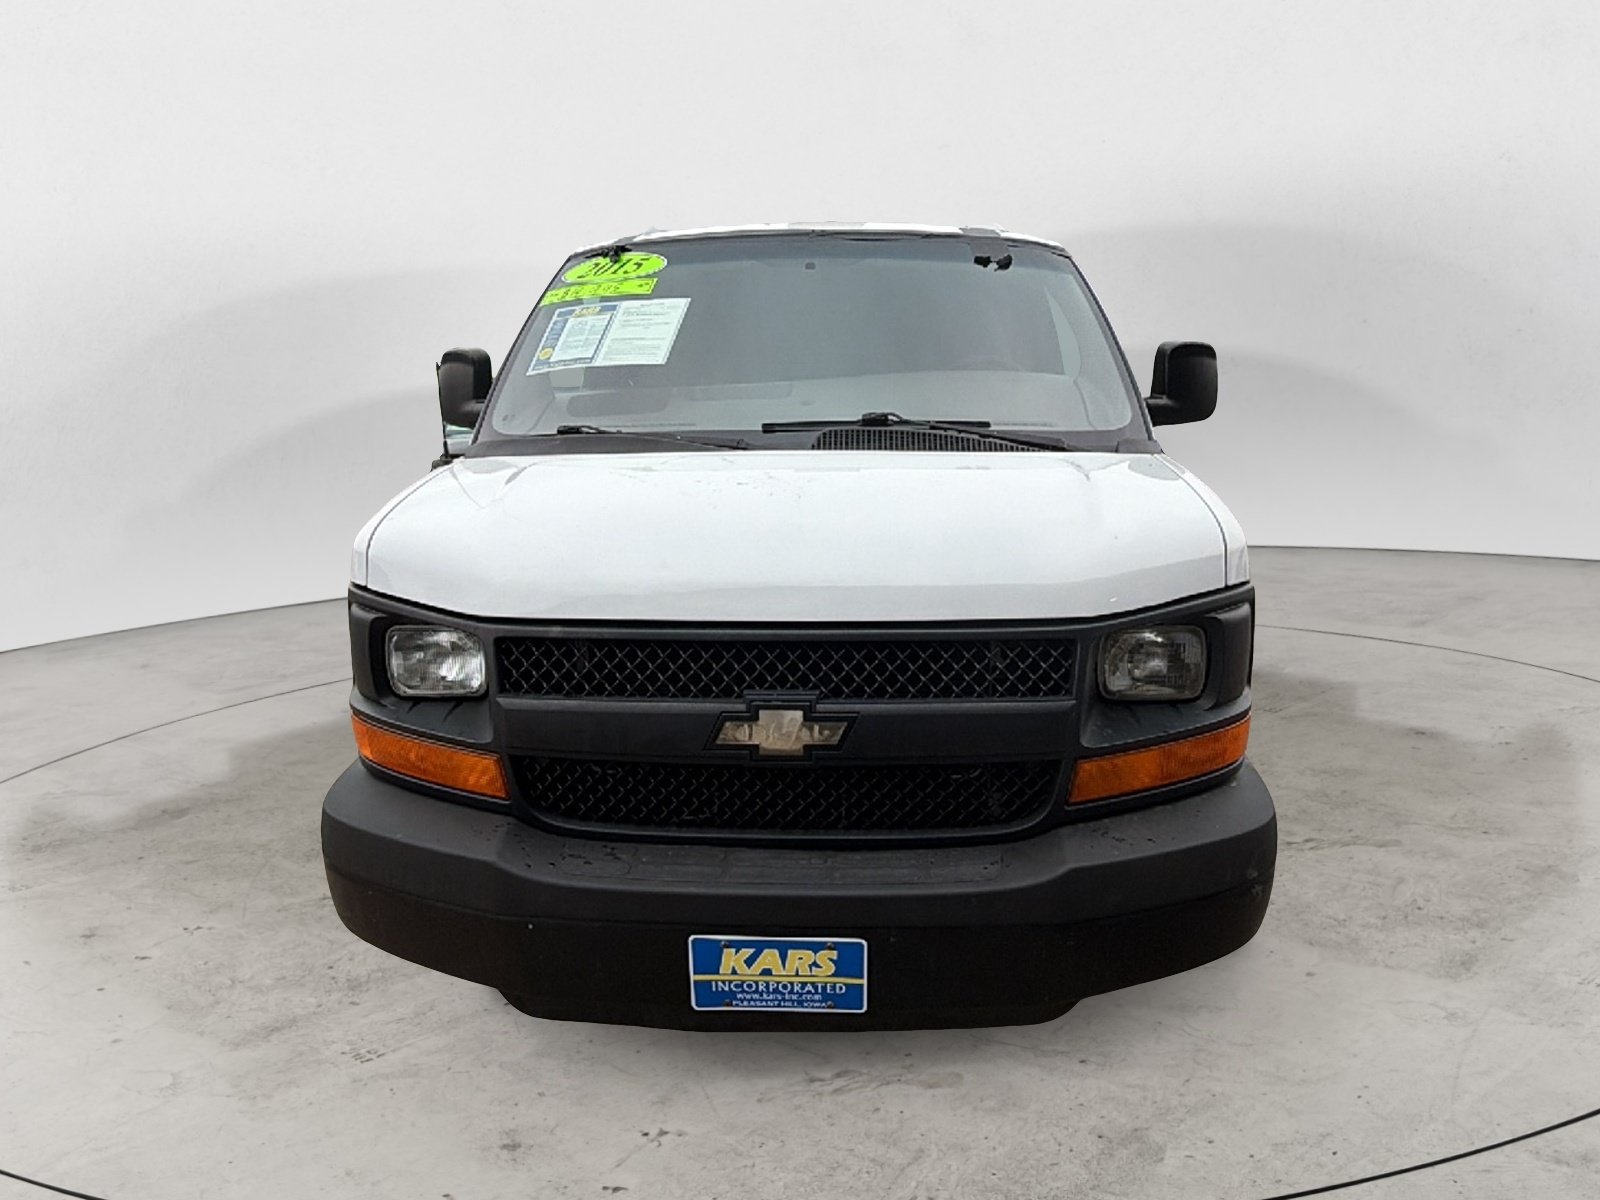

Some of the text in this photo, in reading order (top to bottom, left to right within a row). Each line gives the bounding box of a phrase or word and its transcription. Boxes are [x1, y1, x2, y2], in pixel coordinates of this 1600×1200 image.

[577, 258, 650, 278] 2015
[719, 948, 838, 976] KARS
[712, 981, 846, 994] INCORPORATED
